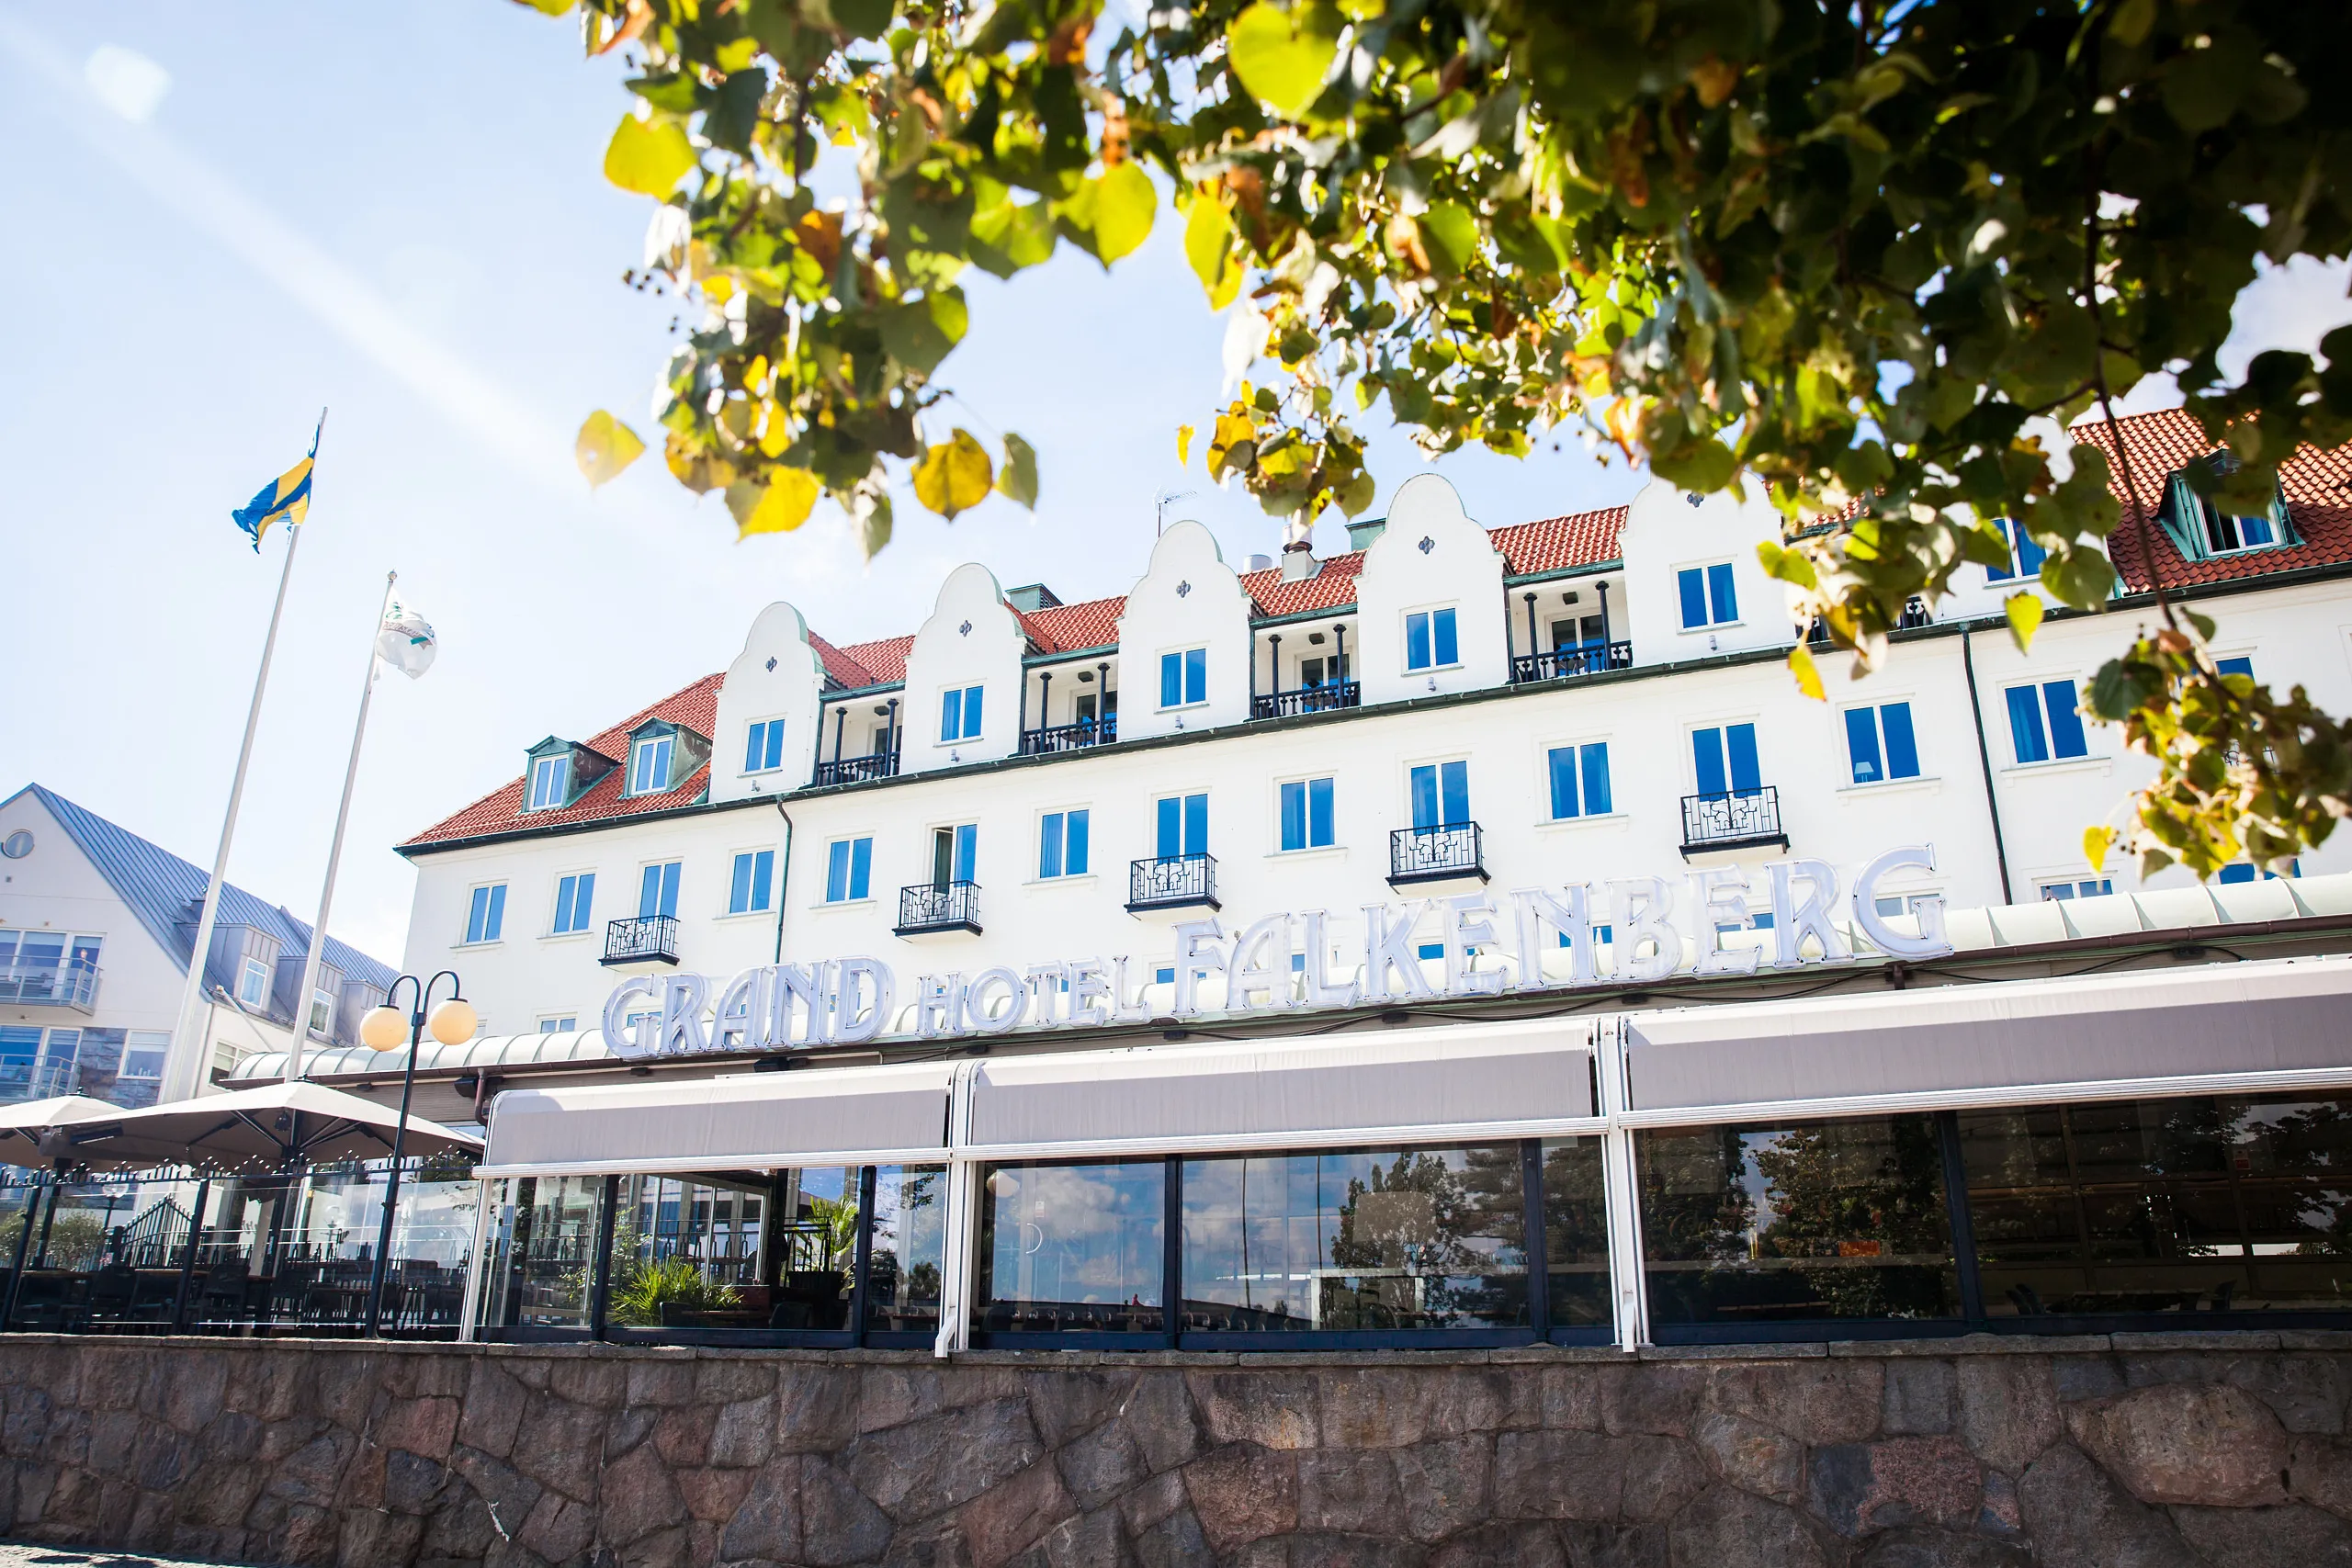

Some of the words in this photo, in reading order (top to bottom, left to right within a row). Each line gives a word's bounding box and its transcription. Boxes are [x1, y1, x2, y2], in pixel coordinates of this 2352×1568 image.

[603, 956, 895, 1060] GRAND
[917, 955, 1152, 1036] HOTEL
[1172, 844, 1953, 1017] FALKENBERG
